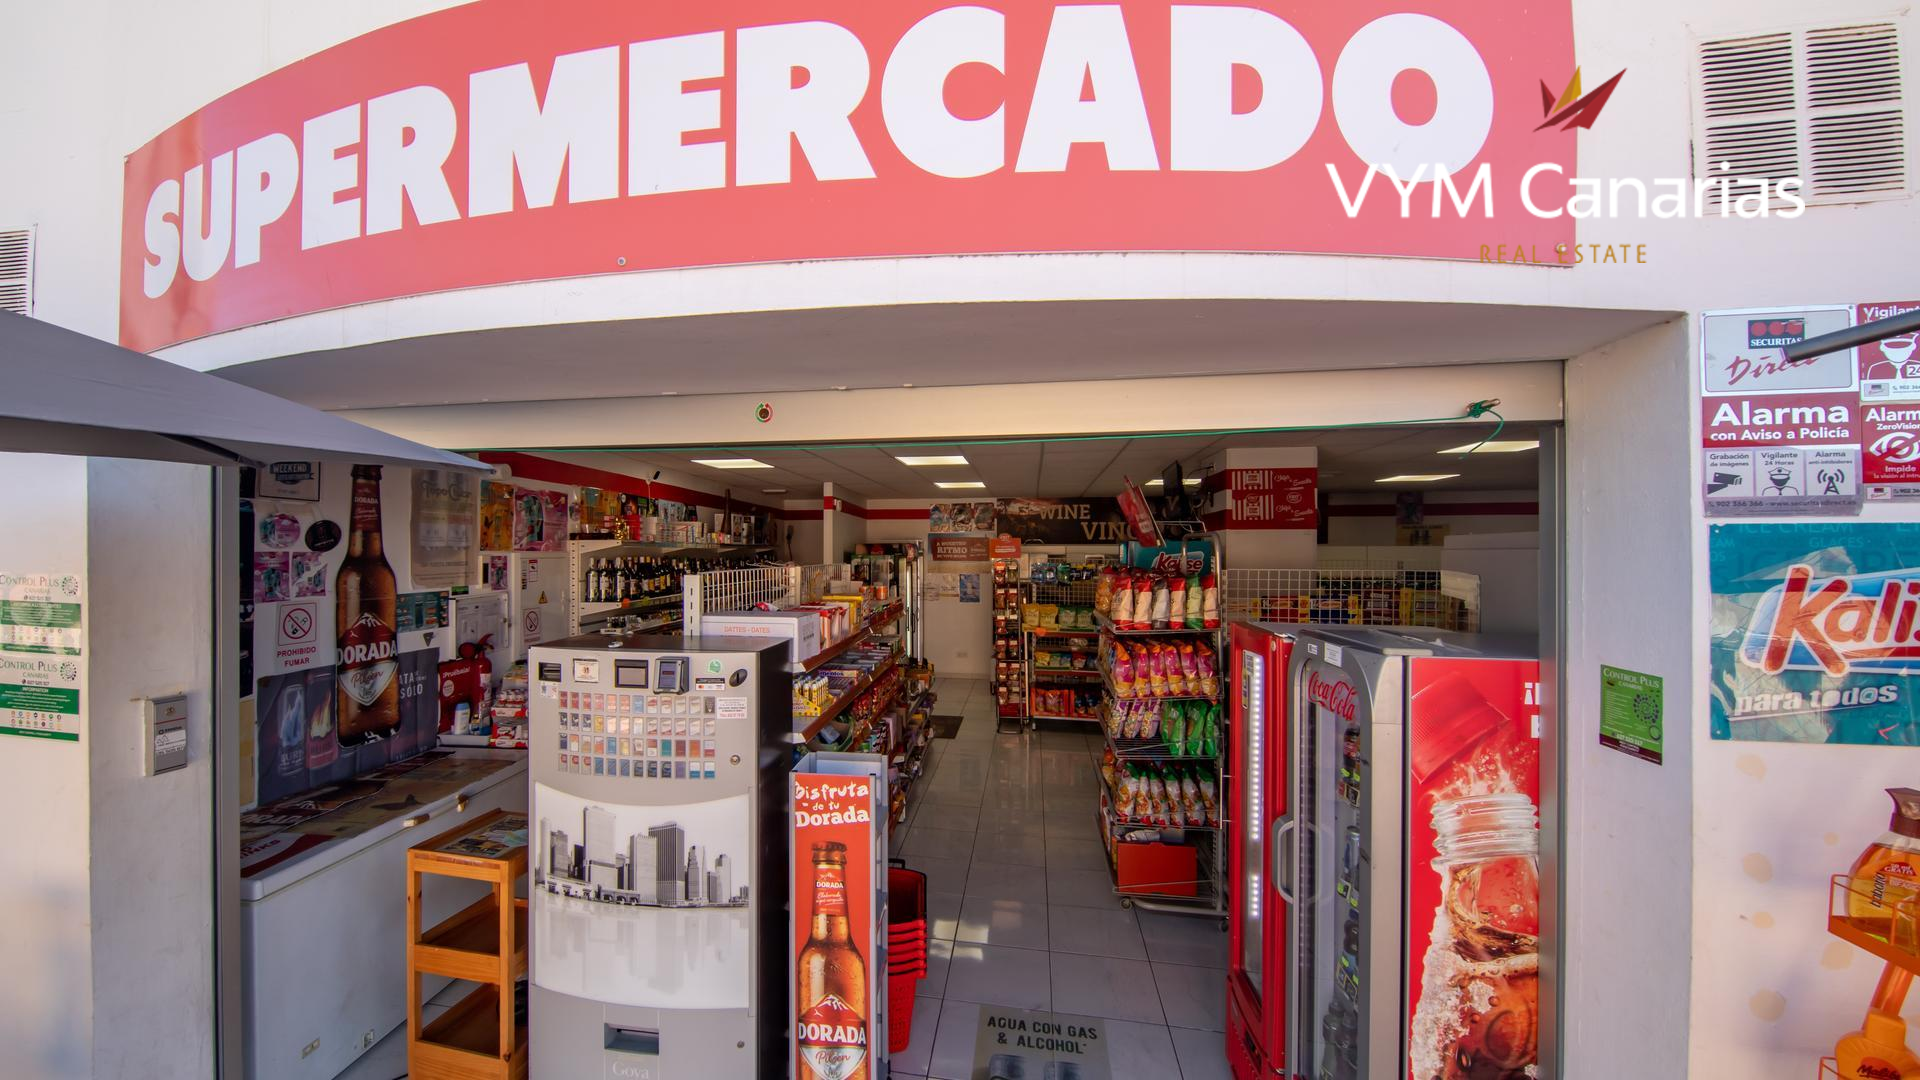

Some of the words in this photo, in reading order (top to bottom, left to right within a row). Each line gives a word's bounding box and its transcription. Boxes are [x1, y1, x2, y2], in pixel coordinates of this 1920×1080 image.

[144, 4, 1495, 299] SUPERMERCADO
[1711, 401, 1849, 426] Alarma
[1710, 431, 1737, 441] con
[1741, 429, 1782, 440] Aviso
[1787, 431, 1795, 439] a
[1800, 427, 1849, 439] Policía
[1710, 453, 1749, 461] Grabación
[1761, 452, 1798, 460] Vigilante
[1885, 465, 1916, 476] Impide
[1039, 503, 1091, 520] WINE
[1157, 552, 1203, 573] Kalse
[1763, 565, 1920, 676] Kali
[276, 646, 317, 658] PROHIBIDO
[337, 641, 398, 665] DORADA
[284, 657, 310, 668] FUMAR
[1735, 691, 1803, 716] para
[1809, 685, 1898, 709] todos
[795, 781, 869, 801] Disfruta
[812, 802, 824, 811] de
[828, 802, 840, 810] tu
[795, 806, 870, 828] Dorada
[816, 881, 844, 889] DORADA
[798, 1022, 866, 1045] DORADA
[997, 1031, 1007, 1045] &
[1032, 1021, 1062, 1036] CON
[1067, 1025, 1098, 1040] GAS
[815, 1050, 851, 1065] Pilsen
